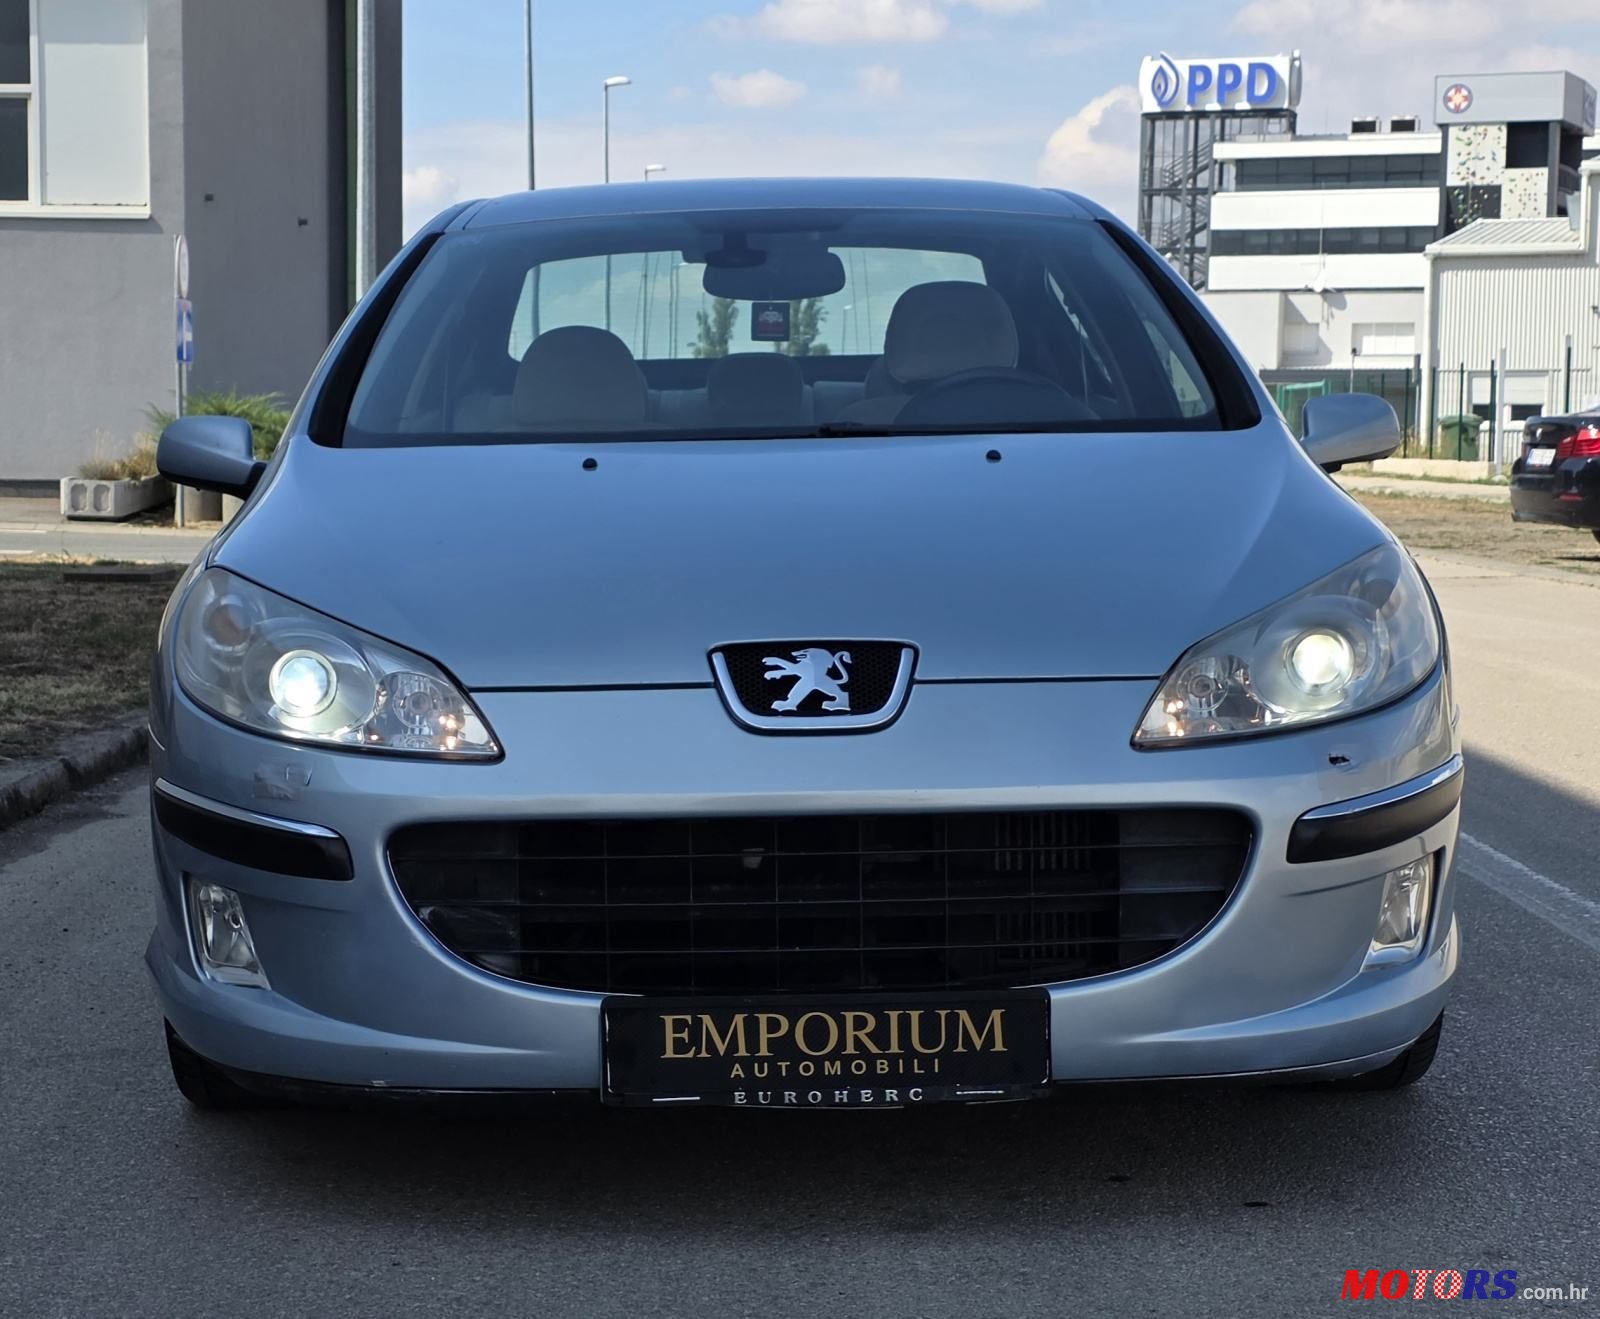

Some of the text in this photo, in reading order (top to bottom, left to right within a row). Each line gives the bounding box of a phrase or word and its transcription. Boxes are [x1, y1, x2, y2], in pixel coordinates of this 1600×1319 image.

[1187, 62, 1277, 107] PPD
[660, 1009, 1008, 1059] EMPORIUM
[730, 1058, 940, 1078] AUTOMOBILI
[734, 1088, 923, 1104] EUROHERC
